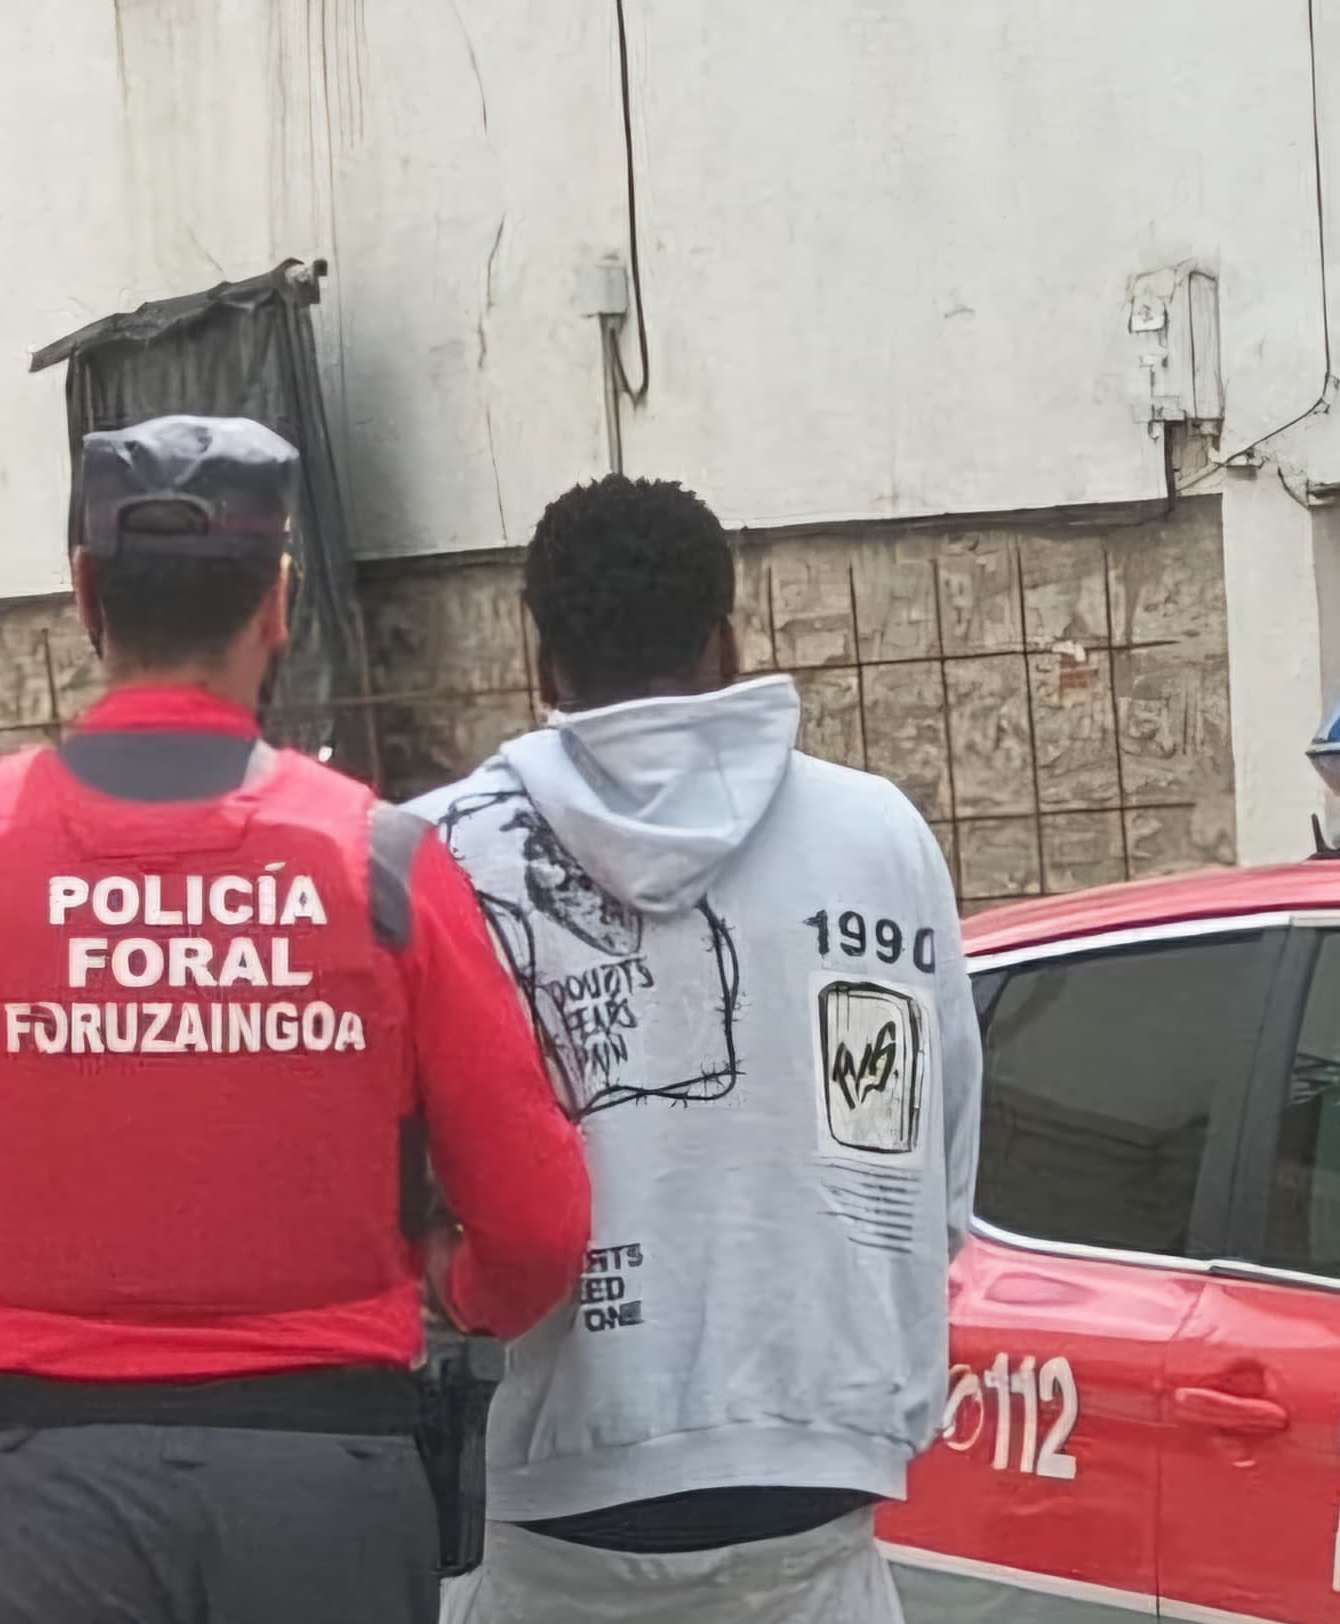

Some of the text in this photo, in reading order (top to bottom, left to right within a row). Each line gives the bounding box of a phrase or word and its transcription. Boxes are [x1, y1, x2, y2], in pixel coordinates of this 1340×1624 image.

[48, 861, 328, 926] POLICÍA
[68, 936, 313, 988] FORAL
[803, 909, 936, 974] 1990
